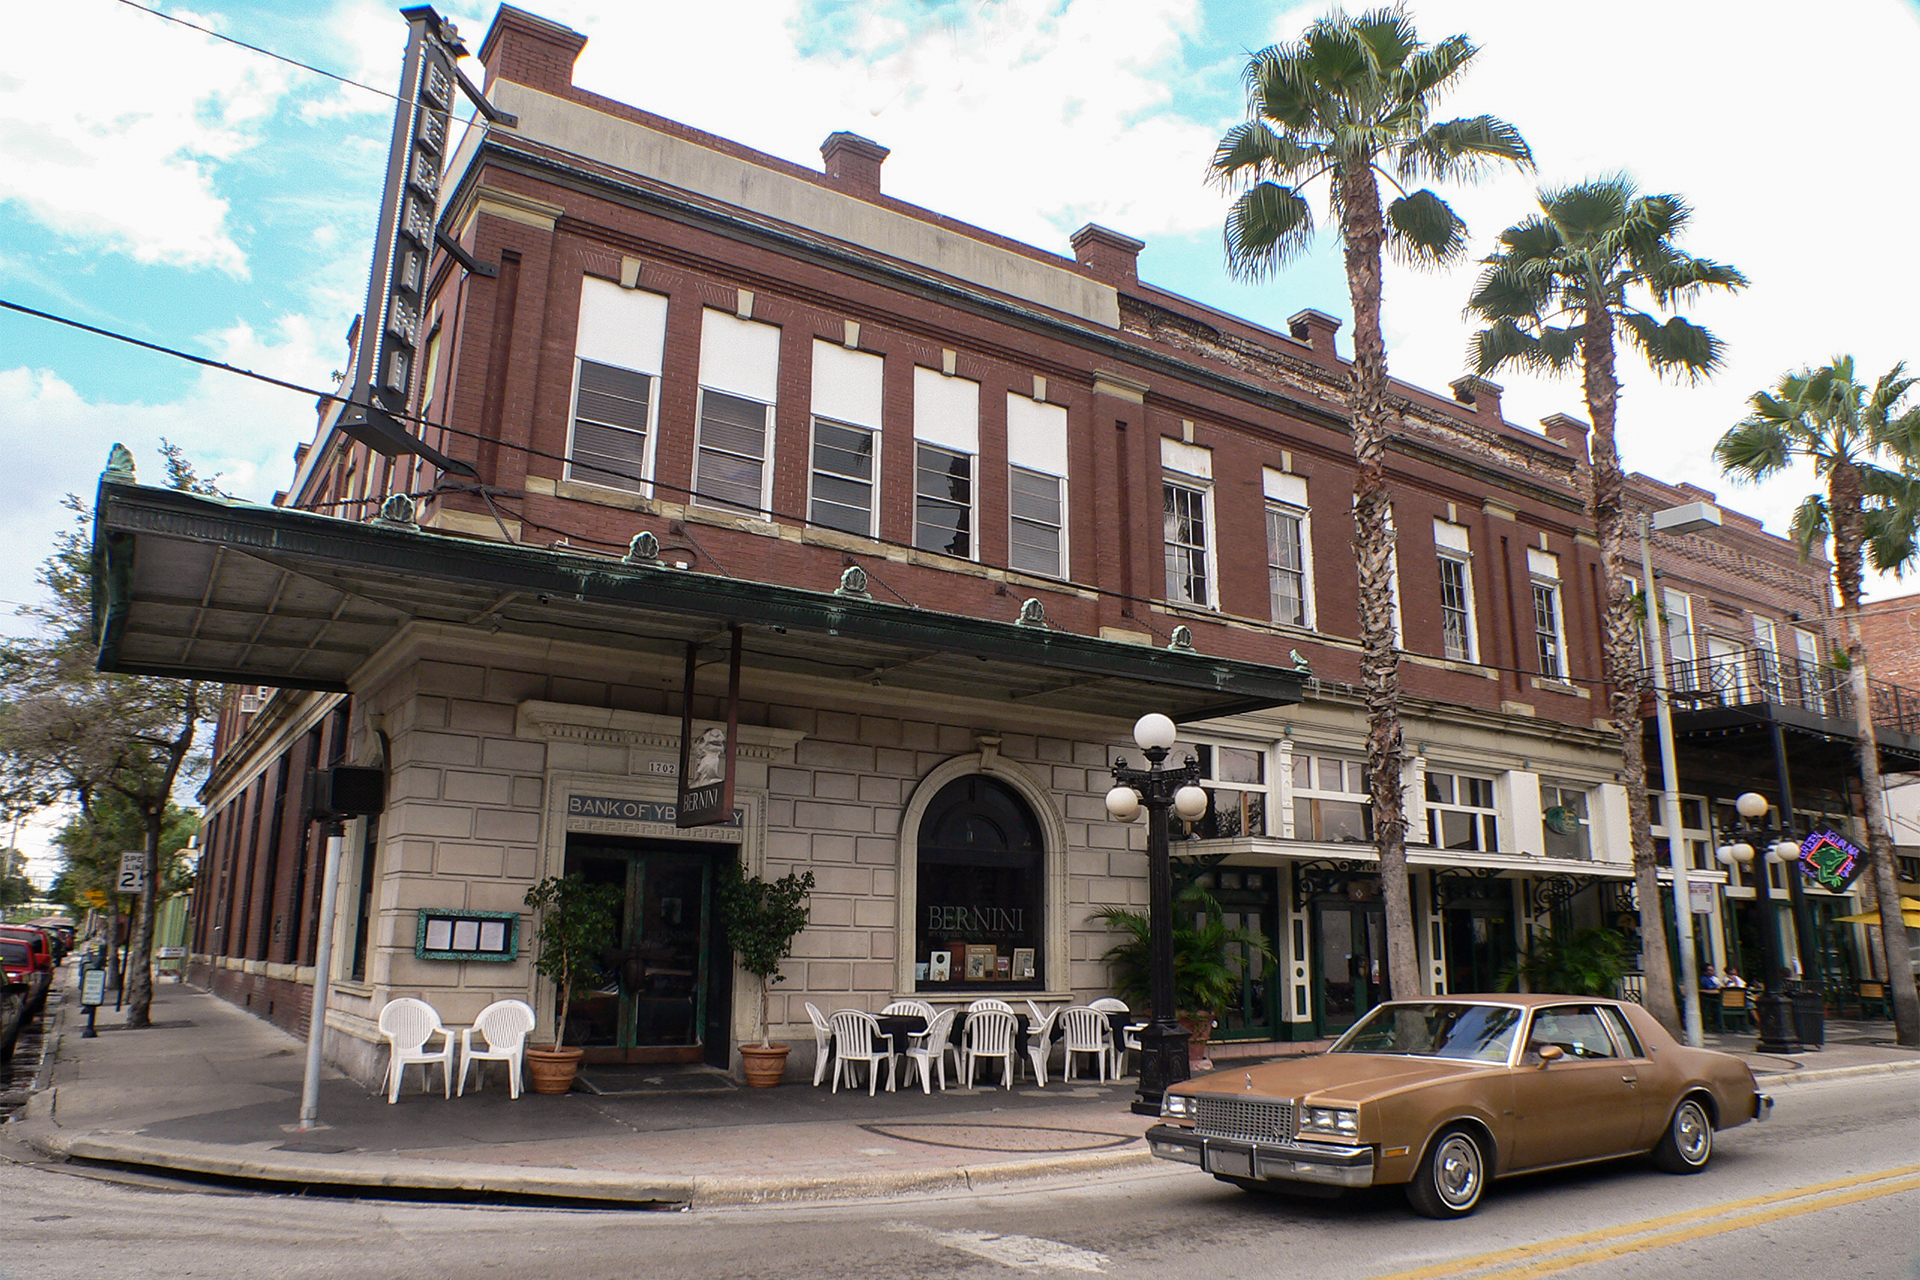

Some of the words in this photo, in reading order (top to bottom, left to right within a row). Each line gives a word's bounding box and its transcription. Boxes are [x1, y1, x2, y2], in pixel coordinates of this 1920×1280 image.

[386, 60, 453, 394] BERNINI
[650, 763, 675, 774] 1702
[569, 797, 620, 816] BANK
[623, 803, 651, 818] OF
[654, 804, 677, 820] YB
[683, 788, 718, 812] BERNINI
[928, 905, 1024, 931] BERNINI
